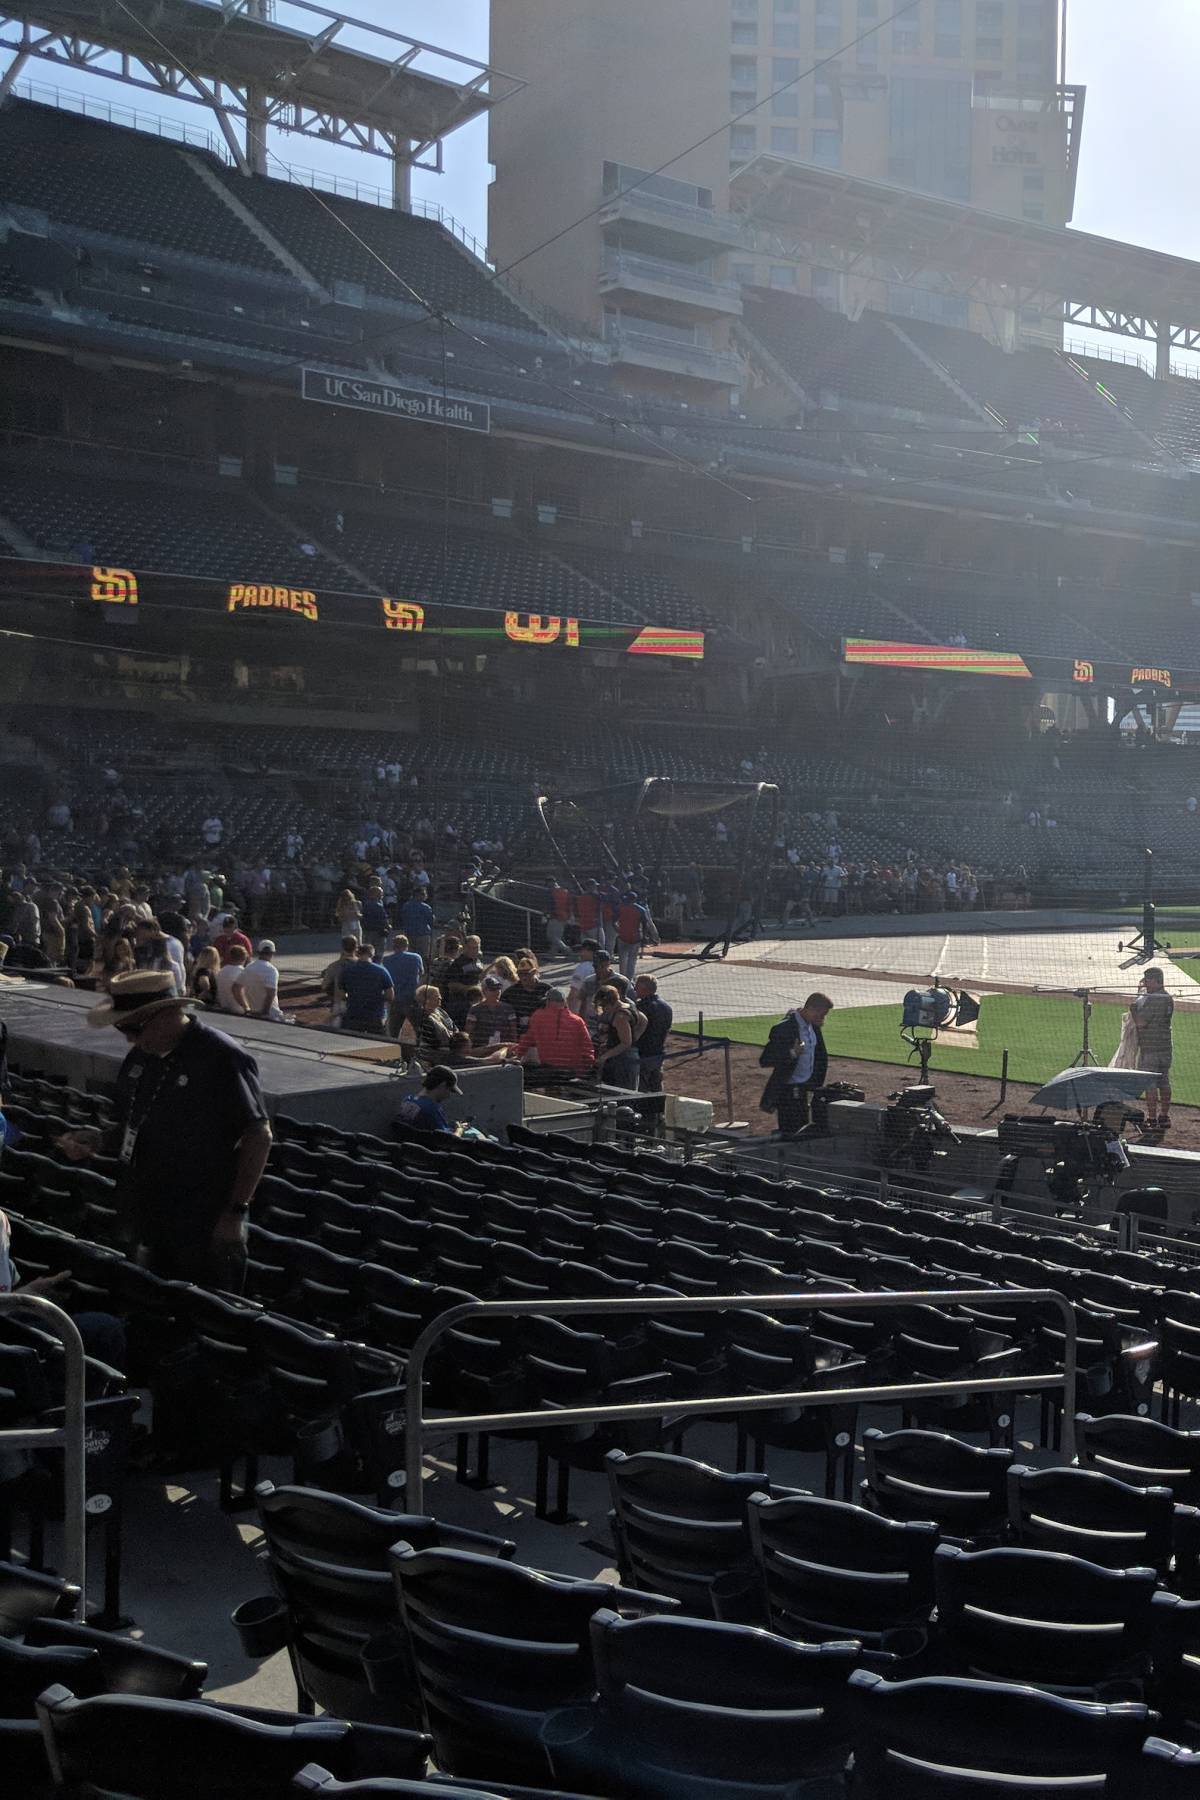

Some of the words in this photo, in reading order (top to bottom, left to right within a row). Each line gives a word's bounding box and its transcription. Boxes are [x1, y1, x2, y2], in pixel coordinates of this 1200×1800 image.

[325, 378, 351, 398] UC
[352, 384, 381, 404] San
[381, 389, 425, 415] Diego
[427, 398, 473, 422] Health
[228, 584, 318, 621] PADRES
[1131, 668, 1171, 688] PADRES
